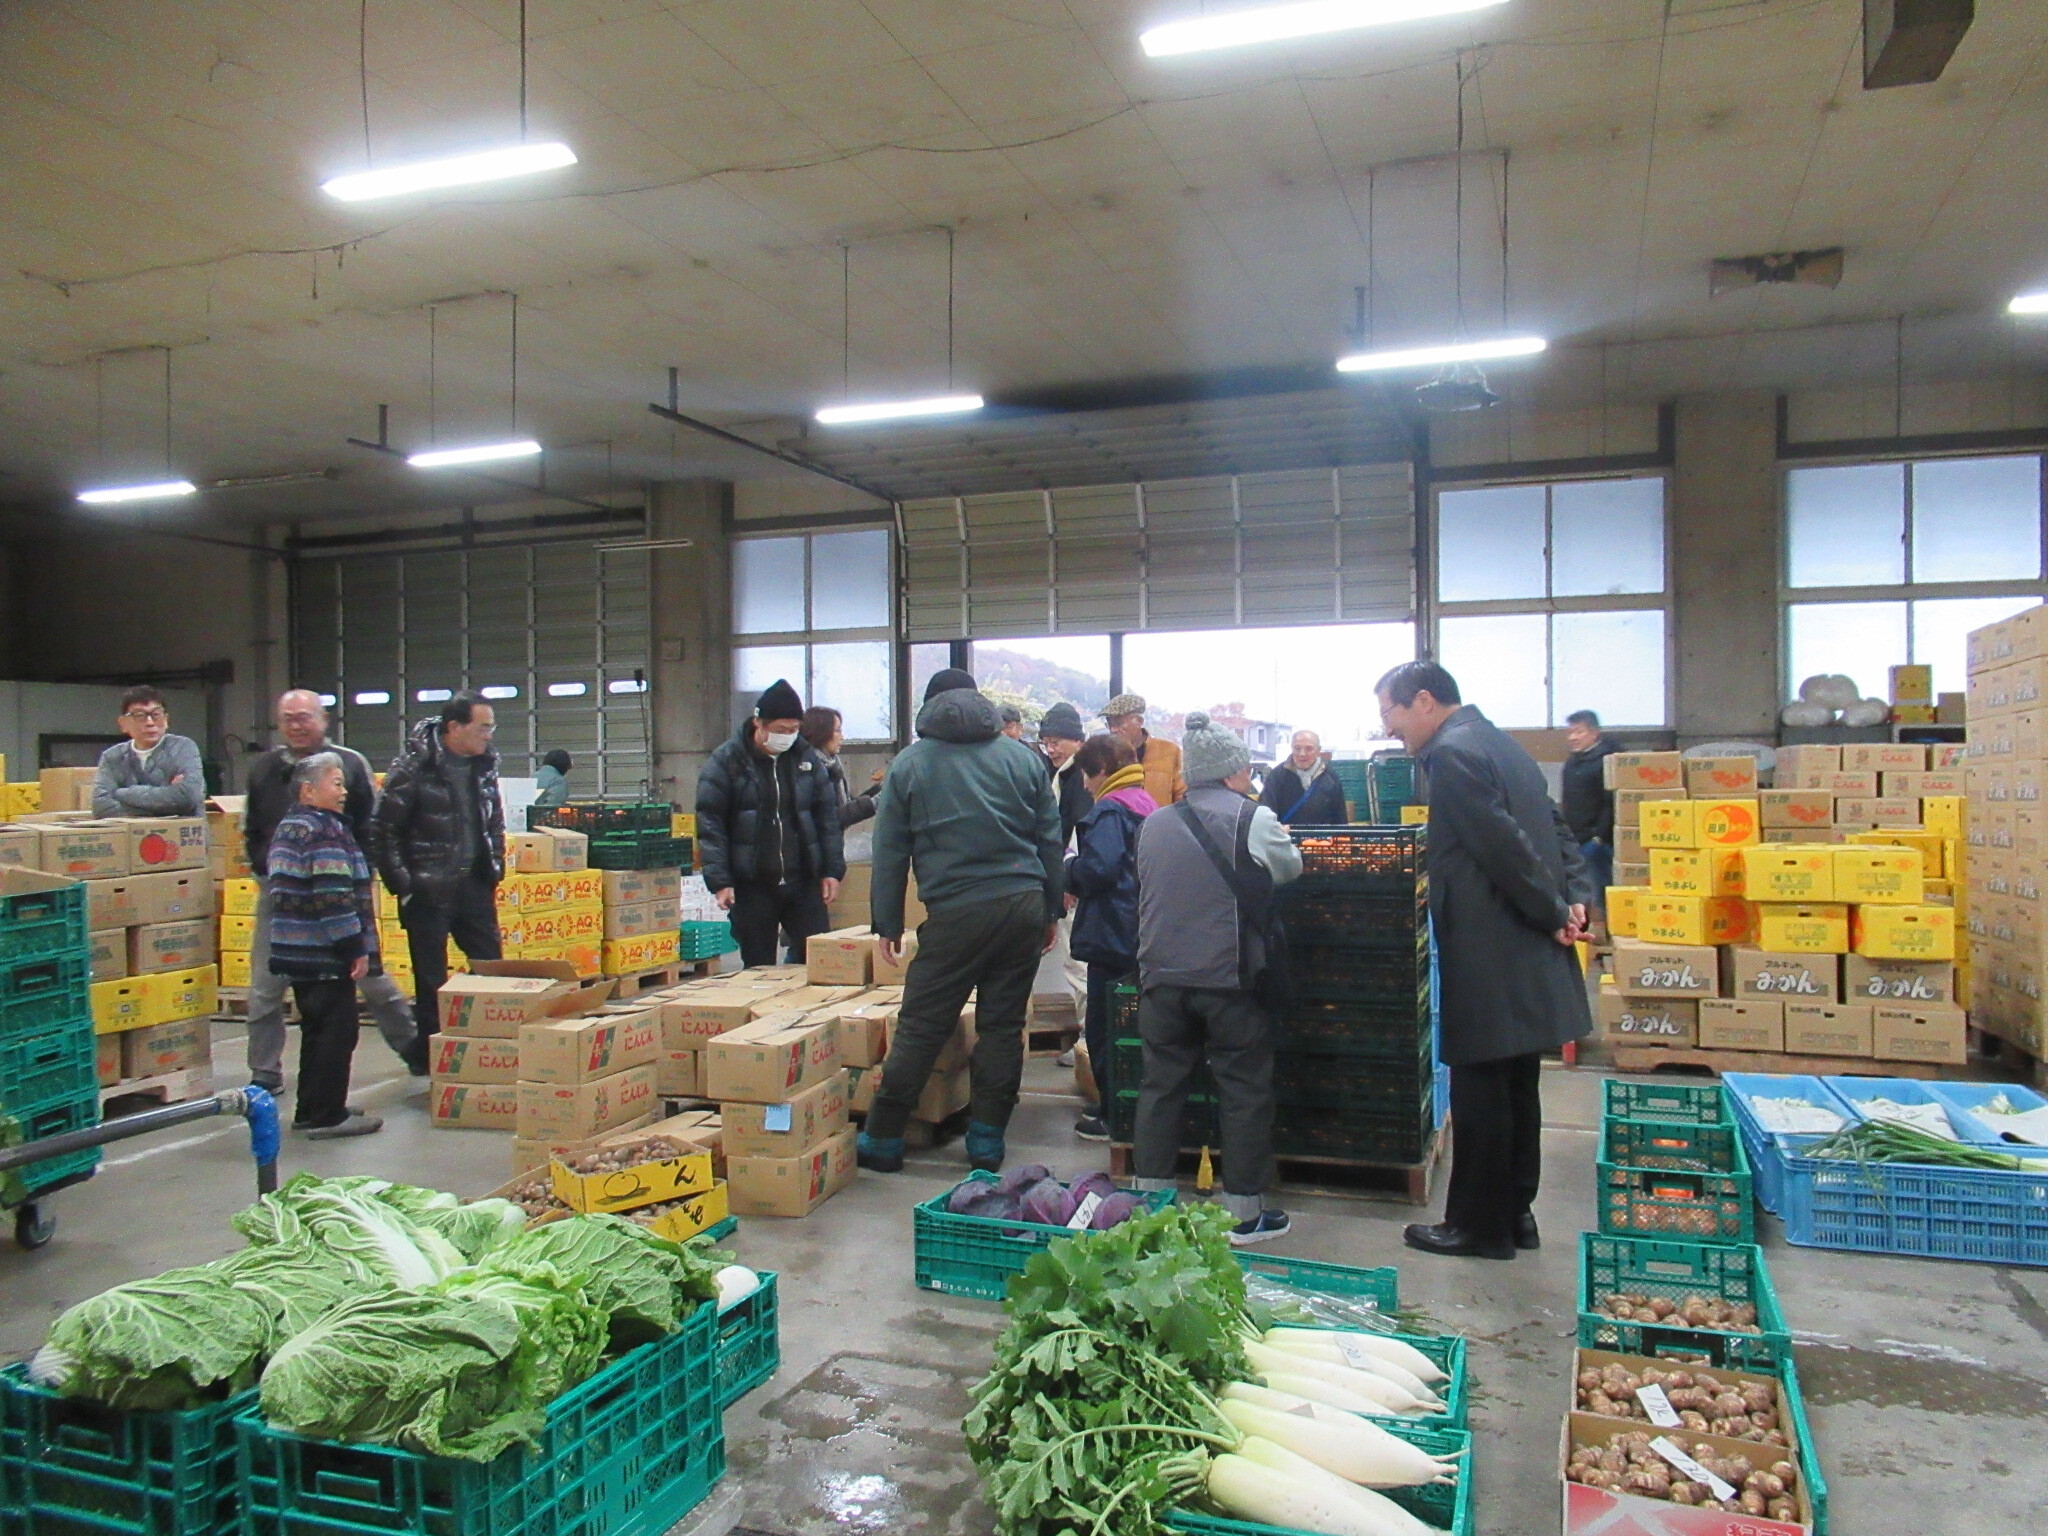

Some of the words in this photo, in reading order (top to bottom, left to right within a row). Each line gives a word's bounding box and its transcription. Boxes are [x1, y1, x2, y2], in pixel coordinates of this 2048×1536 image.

[534, 884, 553, 898] AQ
[574, 880, 592, 893] AQ
[1664, 880, 1697, 891] やまよし
[535, 920, 554, 935] AQ
[576, 915, 594, 928] AQ
[1652, 927, 1686, 938] やまよし
[629, 945, 643, 958] AQ
[659, 940, 673, 952] AQ
[1640, 964, 1701, 988] みかん
[1756, 970, 1820, 994] みかん
[1868, 975, 1936, 999] みかん
[681, 1021, 725, 1035] にんじん
[1620, 1012, 1682, 1035] みかん
[624, 1028, 654, 1051] にんじん
[620, 1081, 650, 1105] にんじん
